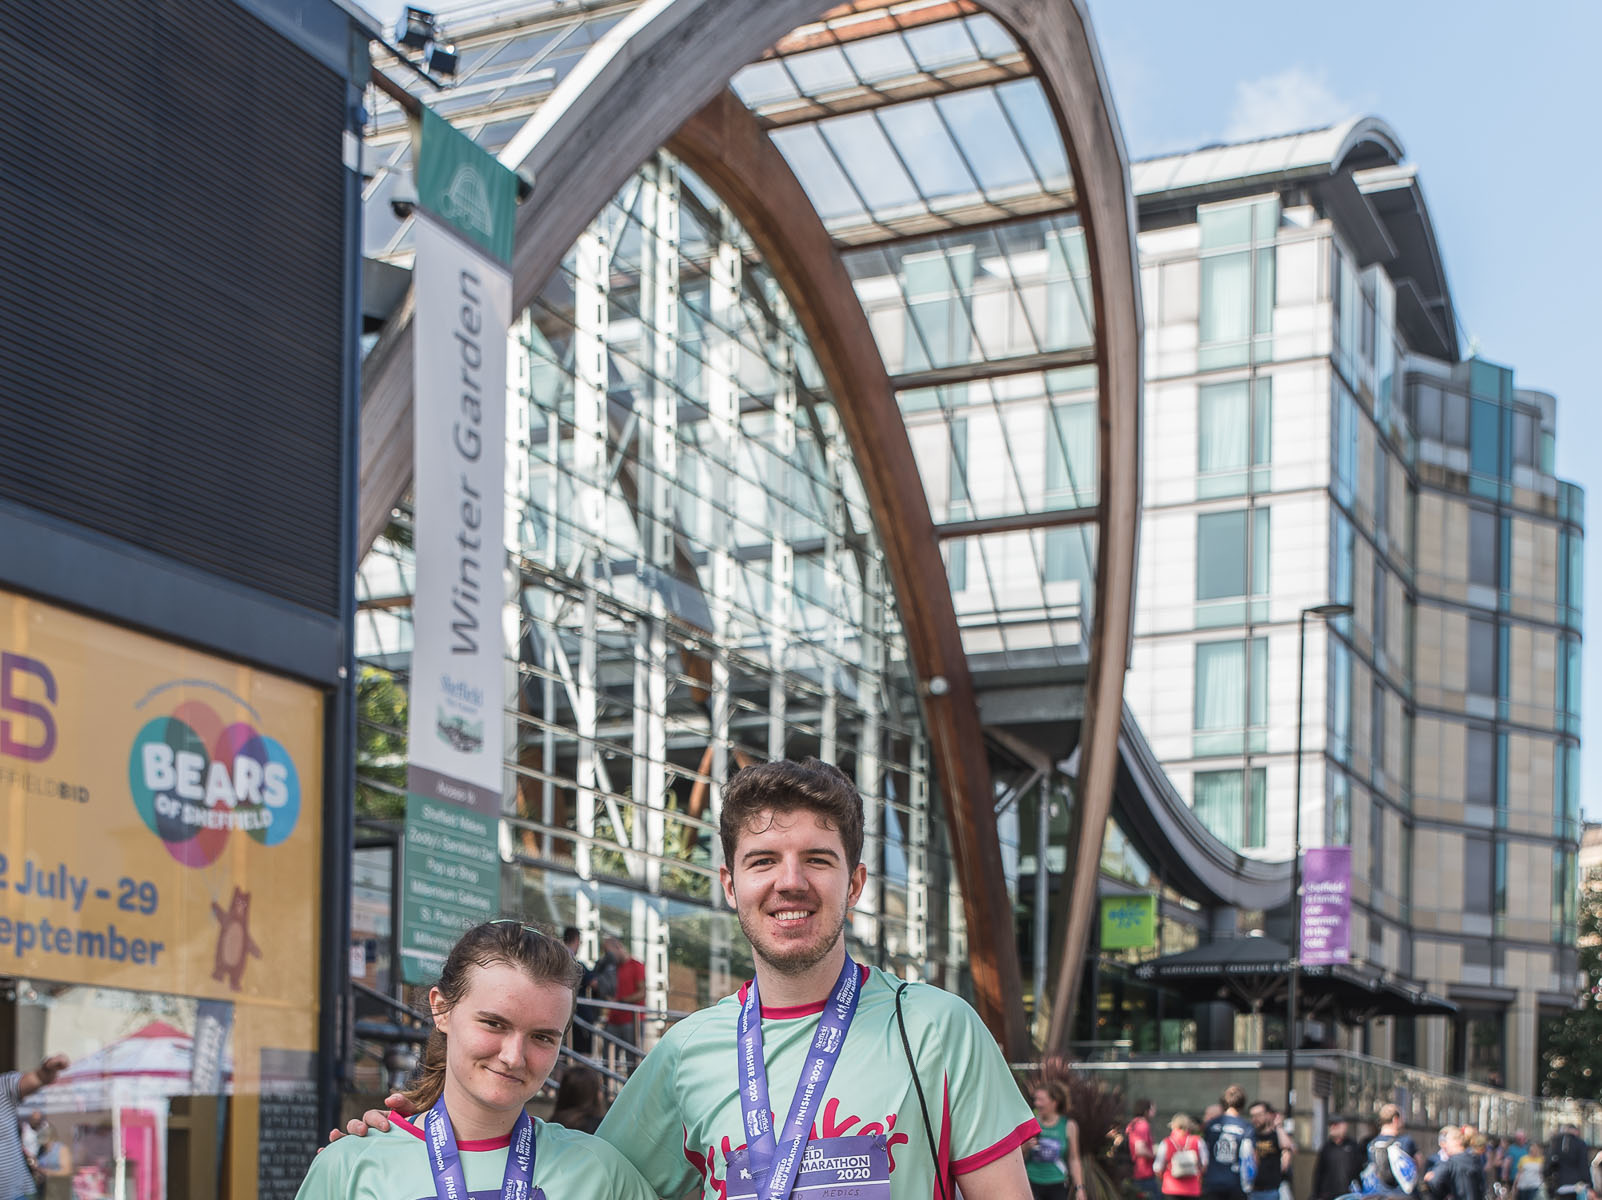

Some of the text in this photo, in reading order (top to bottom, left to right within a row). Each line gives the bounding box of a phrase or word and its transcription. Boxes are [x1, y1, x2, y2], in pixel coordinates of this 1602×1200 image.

[451, 269, 482, 655] Winter Garden
[142, 742, 288, 808] BEARS
[155, 793, 273, 831] OF SHEFFIELD
[15, 860, 88, 912] July
[117, 876, 159, 915] 29
[745, 1037, 759, 1102] FINISHER 2020
[795, 1078, 817, 1126] FINISHER
[810, 1058, 825, 1082] 2020
[784, 1134, 802, 1175] MARATHON
[800, 1156, 869, 1173] MARATHON
[837, 1167, 870, 1180] 2020
